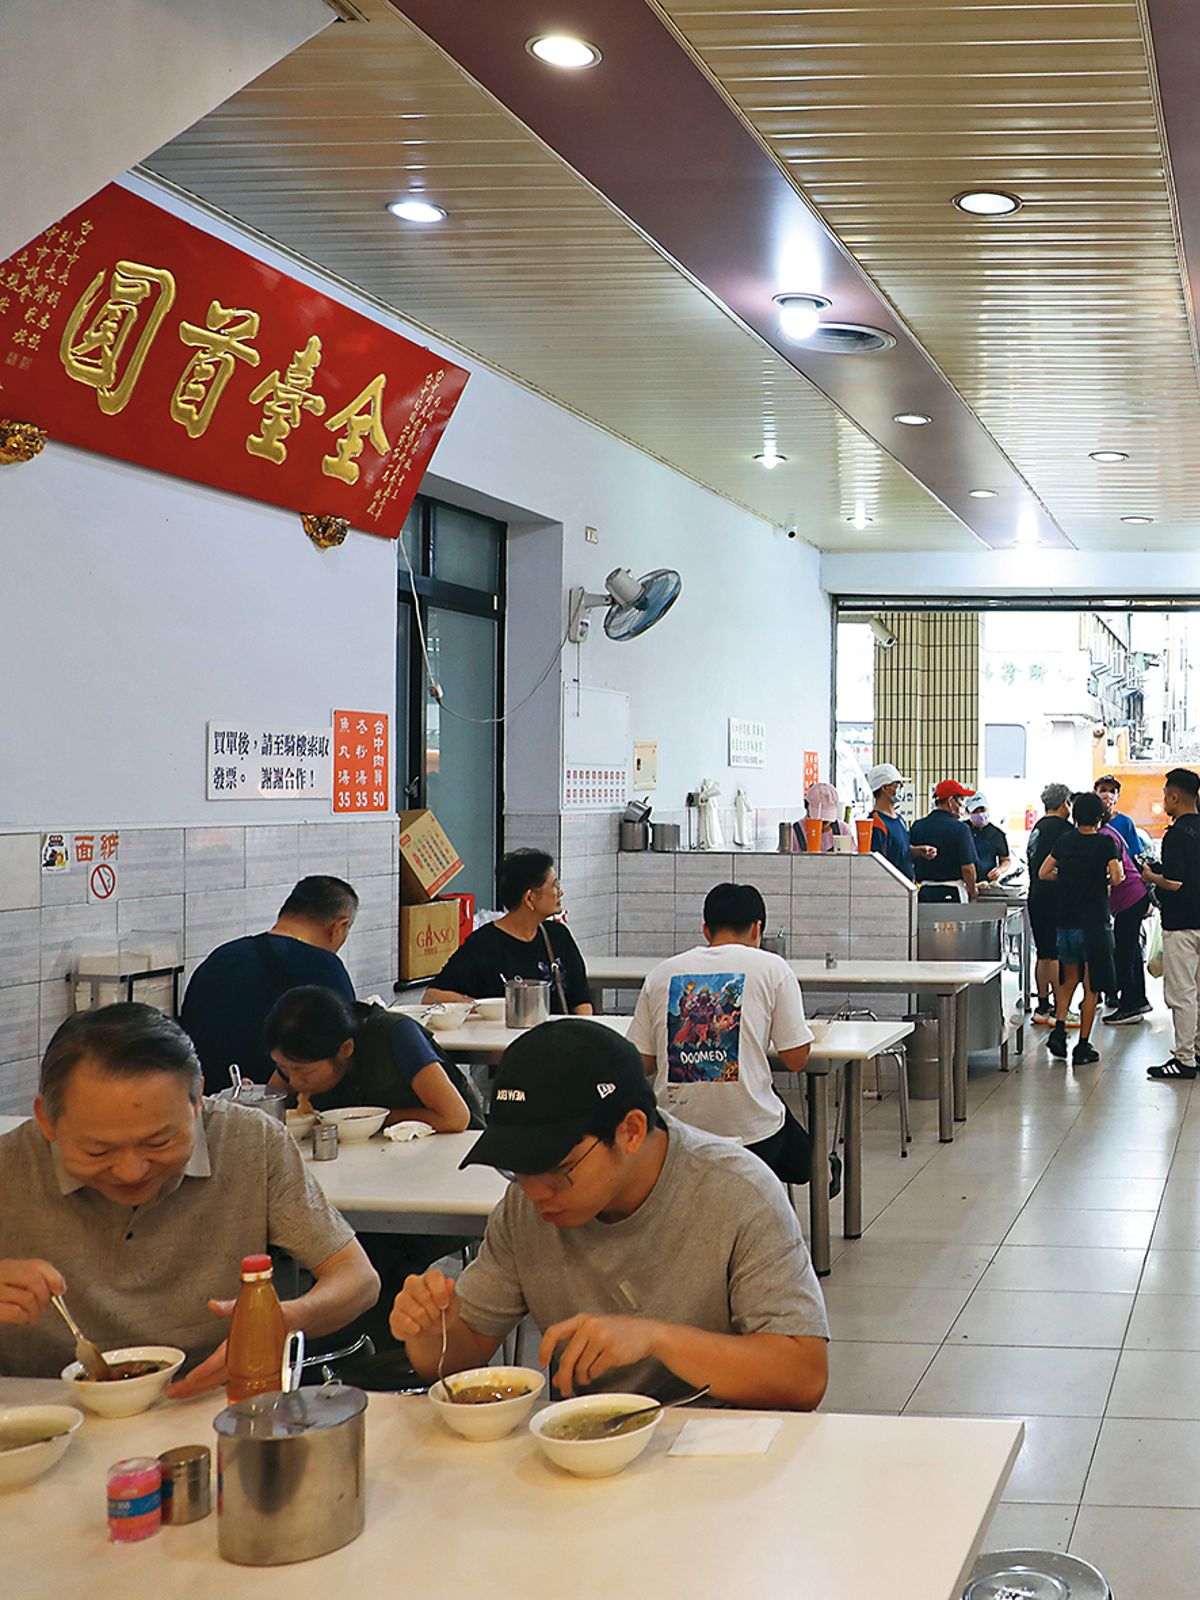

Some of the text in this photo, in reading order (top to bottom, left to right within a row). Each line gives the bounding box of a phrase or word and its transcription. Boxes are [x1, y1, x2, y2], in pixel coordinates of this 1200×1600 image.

[338, 791, 351, 807] 35
[356, 791, 368, 807] 35
[373, 791, 385, 807] 50
[416, 923, 455, 949] GANSO
[680, 1050, 727, 1065] DOOMED!
